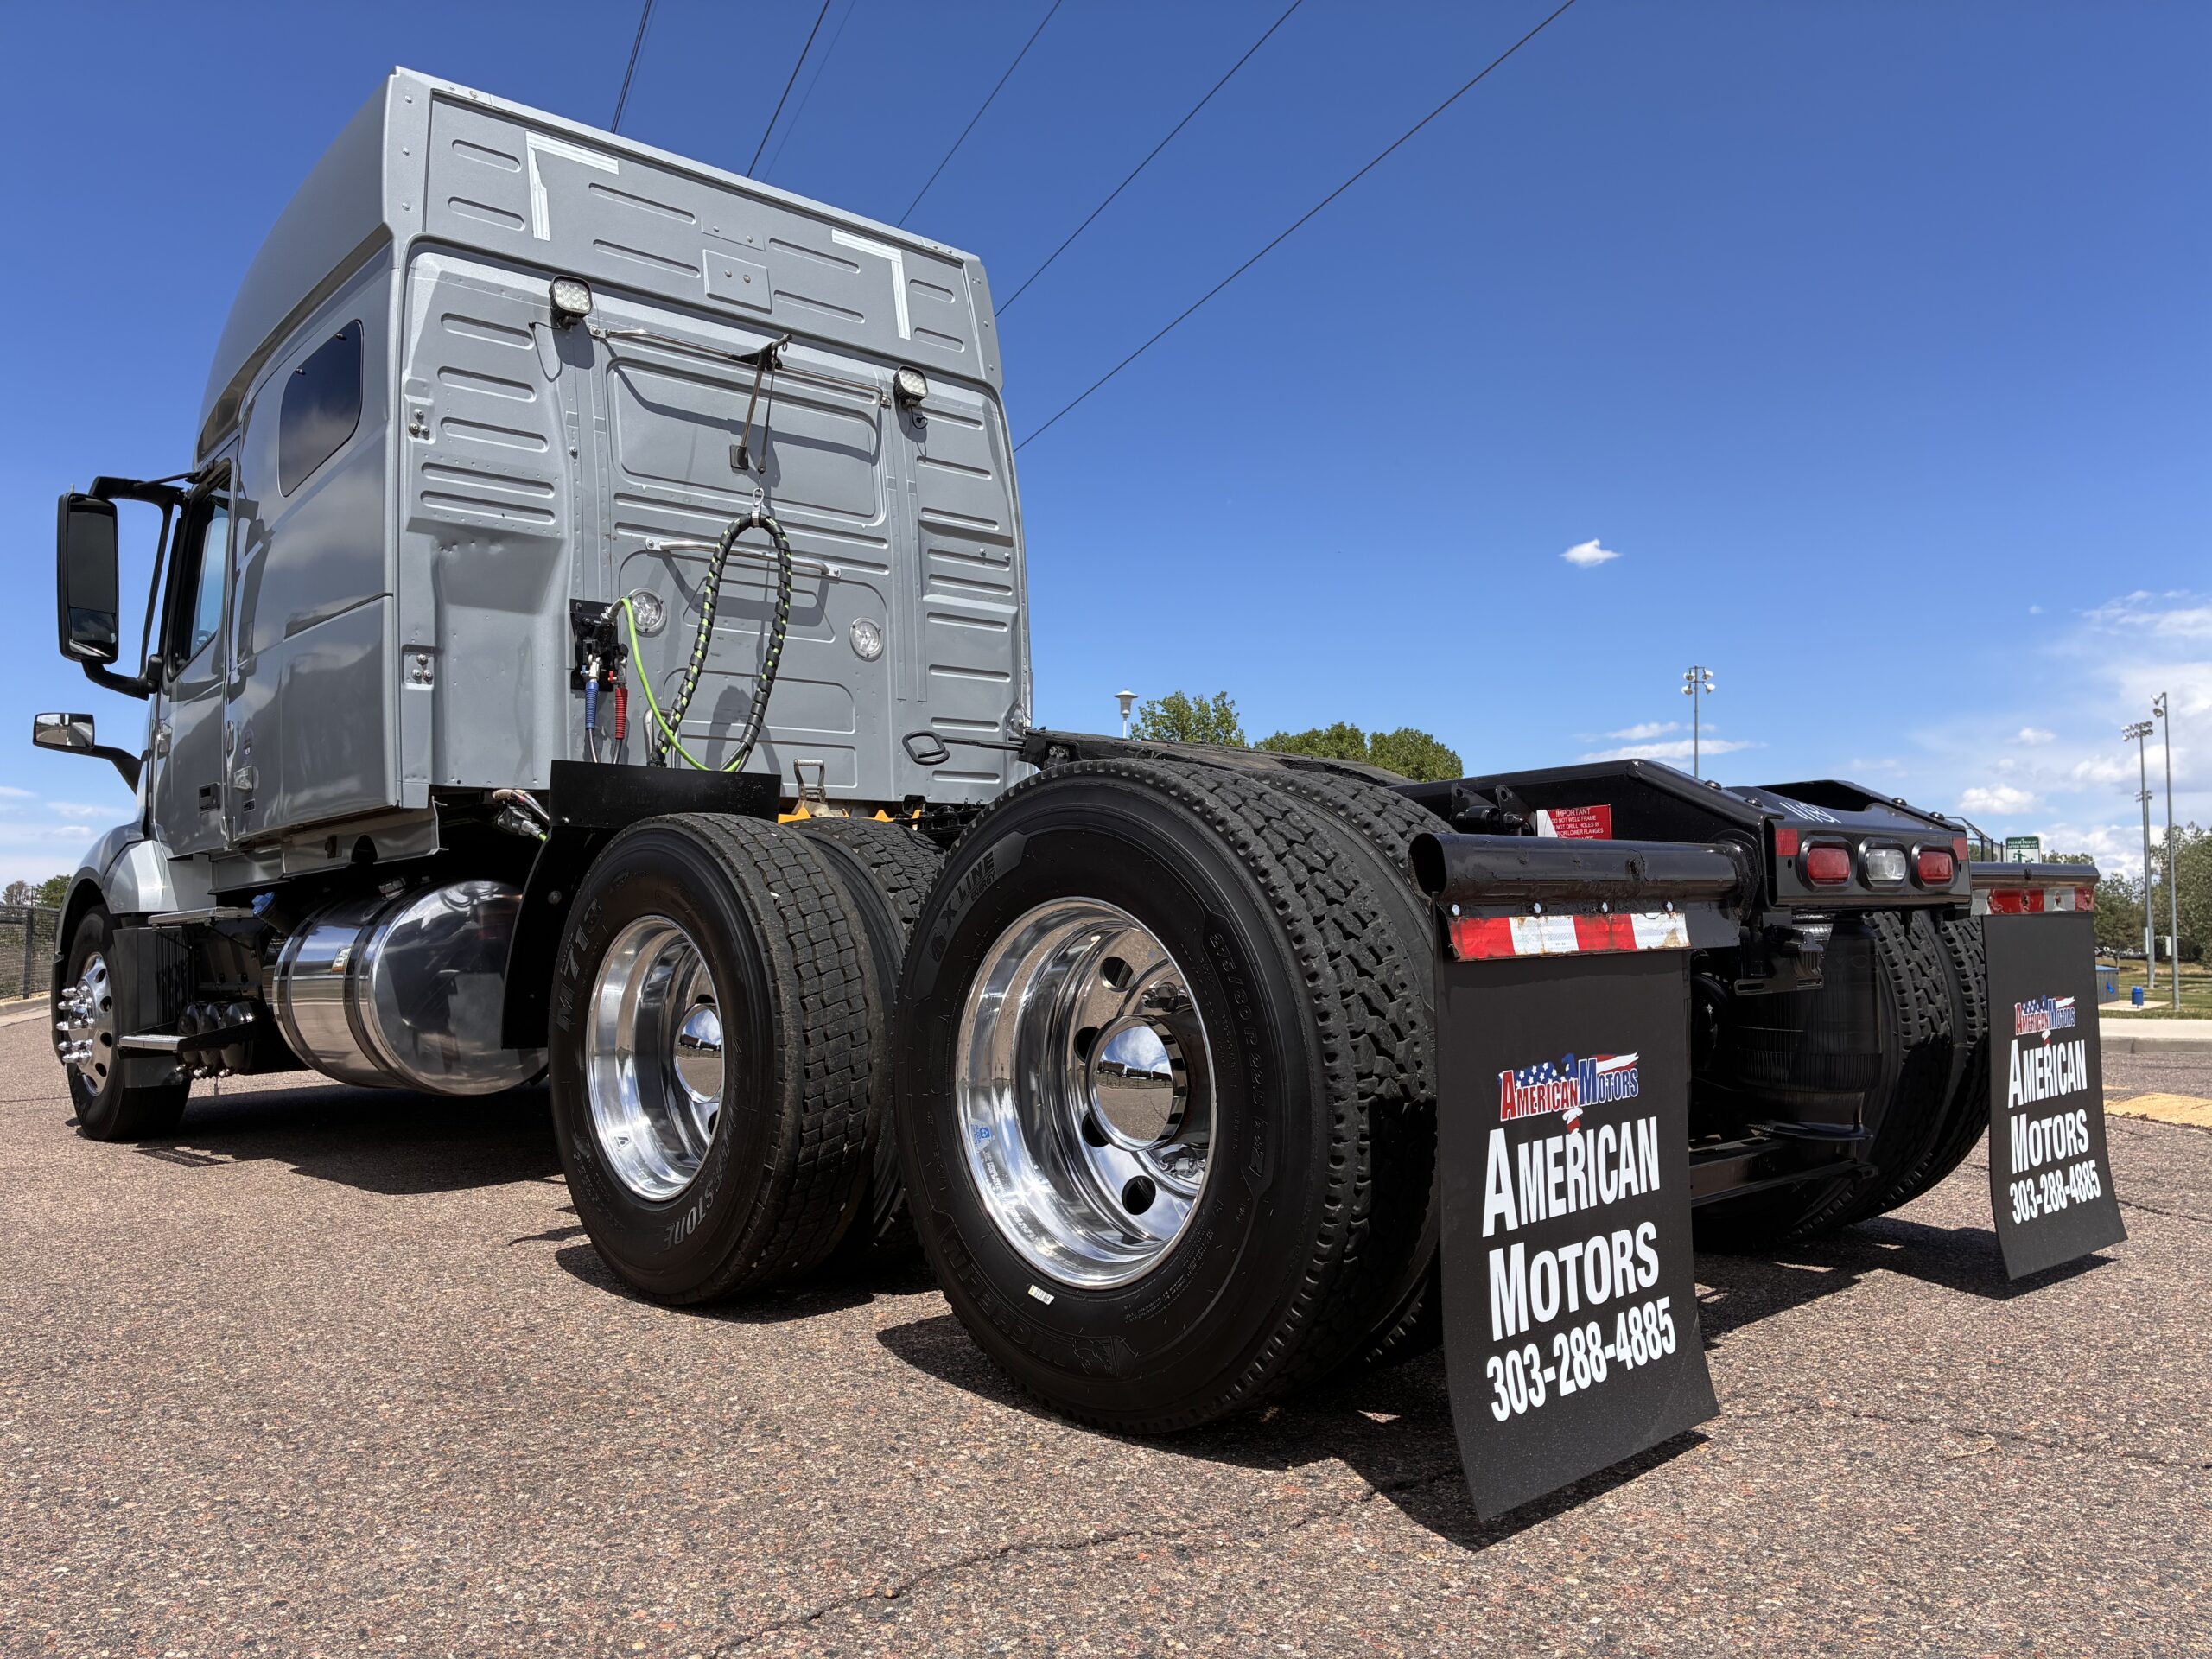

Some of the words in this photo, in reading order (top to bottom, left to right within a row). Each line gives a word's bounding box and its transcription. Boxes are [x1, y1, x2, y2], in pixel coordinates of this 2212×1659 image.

[1555, 808, 1591, 817] IMPORTANT
[957, 850, 995, 902] LINE
[970, 870, 996, 902] ENERGY
[2014, 1001, 2049, 1035] AMERICAN
[2048, 998, 2075, 1030] MOTORS
[1499, 1070, 1579, 1122] AMERICAN
[1578, 1058, 1640, 1107] MOTORS
[2008, 1039, 2088, 1109] AMERICAN
[2011, 1109, 2089, 1174] MOTORS
[1482, 1116, 1661, 1238] AMERICAN
[2009, 1159, 2101, 1224] 303-288-4885
[1488, 1221, 1660, 1341] MOTORS
[1486, 1296, 1676, 1422] 303-288-4885
